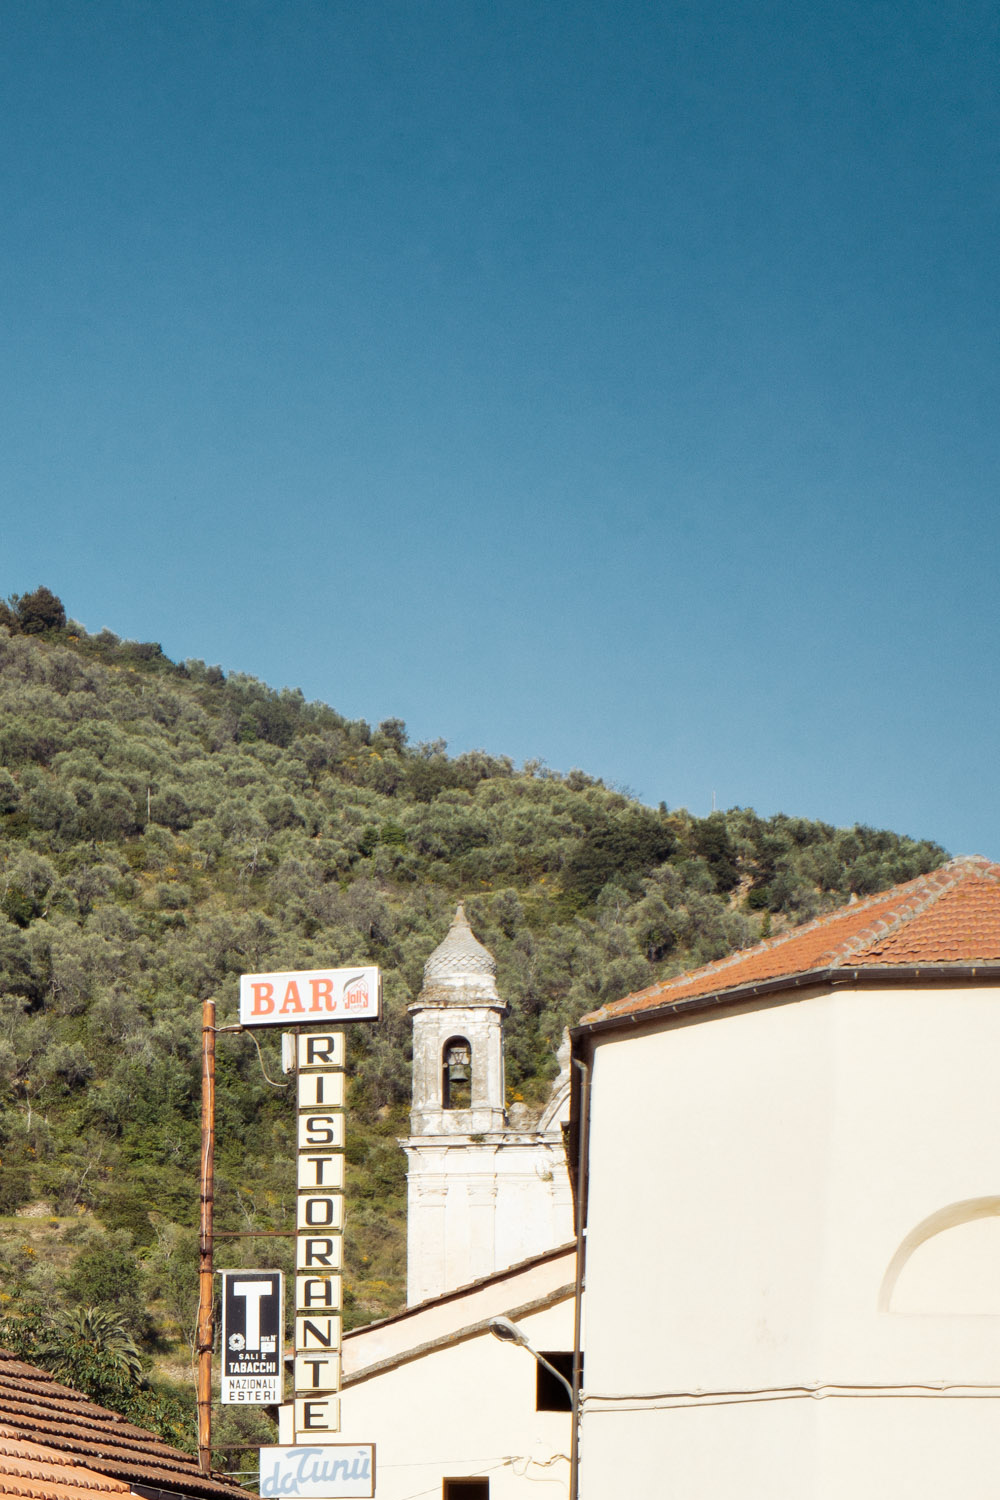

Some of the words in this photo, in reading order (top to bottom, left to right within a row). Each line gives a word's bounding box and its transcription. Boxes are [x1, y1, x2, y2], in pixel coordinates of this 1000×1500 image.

[250, 978, 337, 1016] BAR
[344, 990, 368, 1009] Jolly
[304, 1036, 335, 1429] RISTORANTE
[233, 1281, 273, 1350] T
[229, 1362, 276, 1373] TABACCHI
[229, 1379, 276, 1389] NAZIONALI
[229, 1391, 276, 1401] ESTERI
[261, 1462, 300, 1497] da
